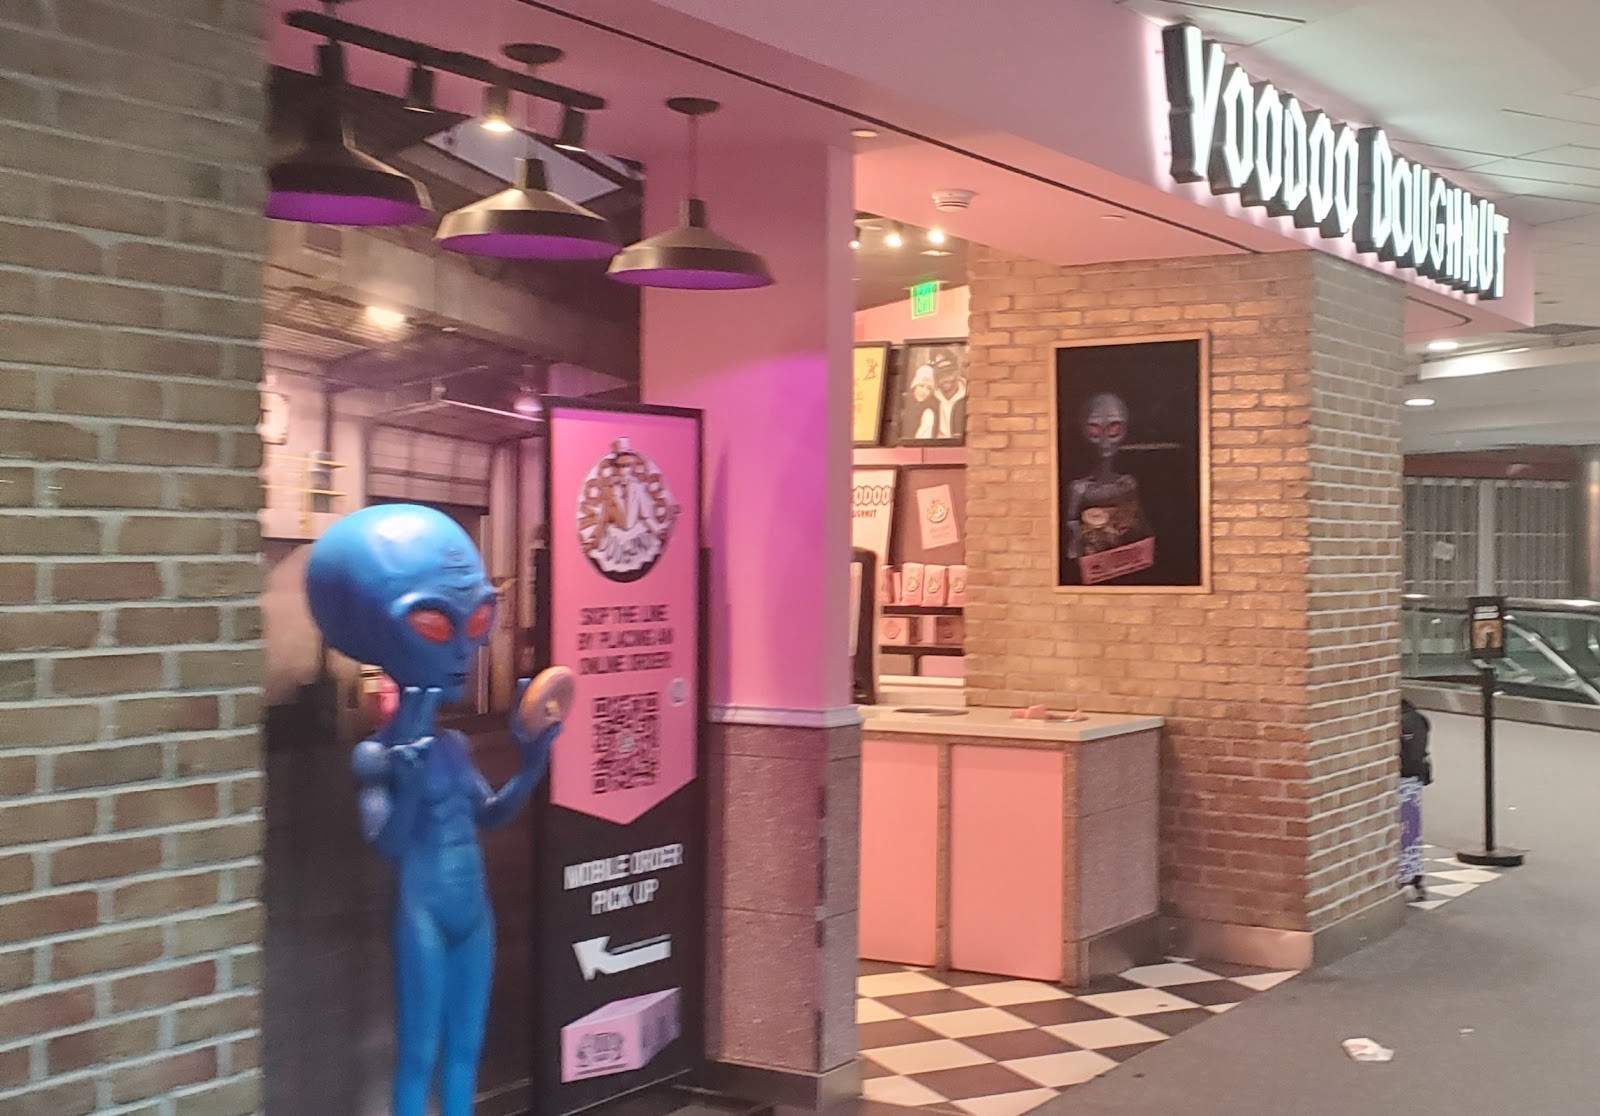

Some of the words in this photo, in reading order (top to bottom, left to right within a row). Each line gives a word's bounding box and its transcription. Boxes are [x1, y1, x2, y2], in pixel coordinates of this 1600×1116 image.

[1180, 25, 1358, 235] VOODOO
[1371, 129, 1510, 298] DOUGHNUT
[633, 878, 660, 905] UP
